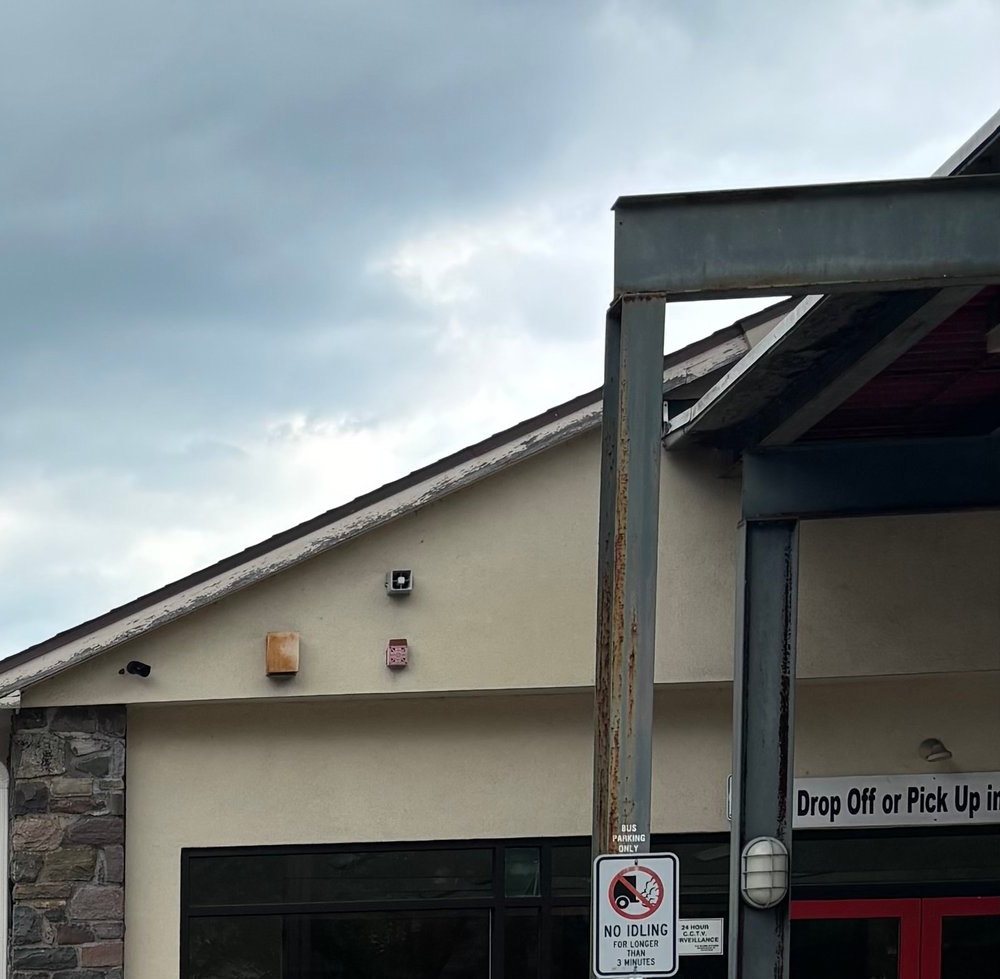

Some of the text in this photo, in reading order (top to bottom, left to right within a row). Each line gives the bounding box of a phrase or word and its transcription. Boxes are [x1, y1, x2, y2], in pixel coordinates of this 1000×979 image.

[797, 789, 841, 822] Drop
[848, 787, 876, 815] Off
[882, 793, 902, 814] or
[907, 786, 948, 813] Pick
[955, 785, 981, 818] Up
[621, 824, 637, 832] BUS
[612, 834, 646, 842] PARKING
[618, 844, 639, 852] ONLY
[604, 923, 668, 938] NO IDLING
[630, 940, 659, 948] LONGER
[627, 949, 646, 957] THAN
[624, 958, 656, 966] MINUTES
